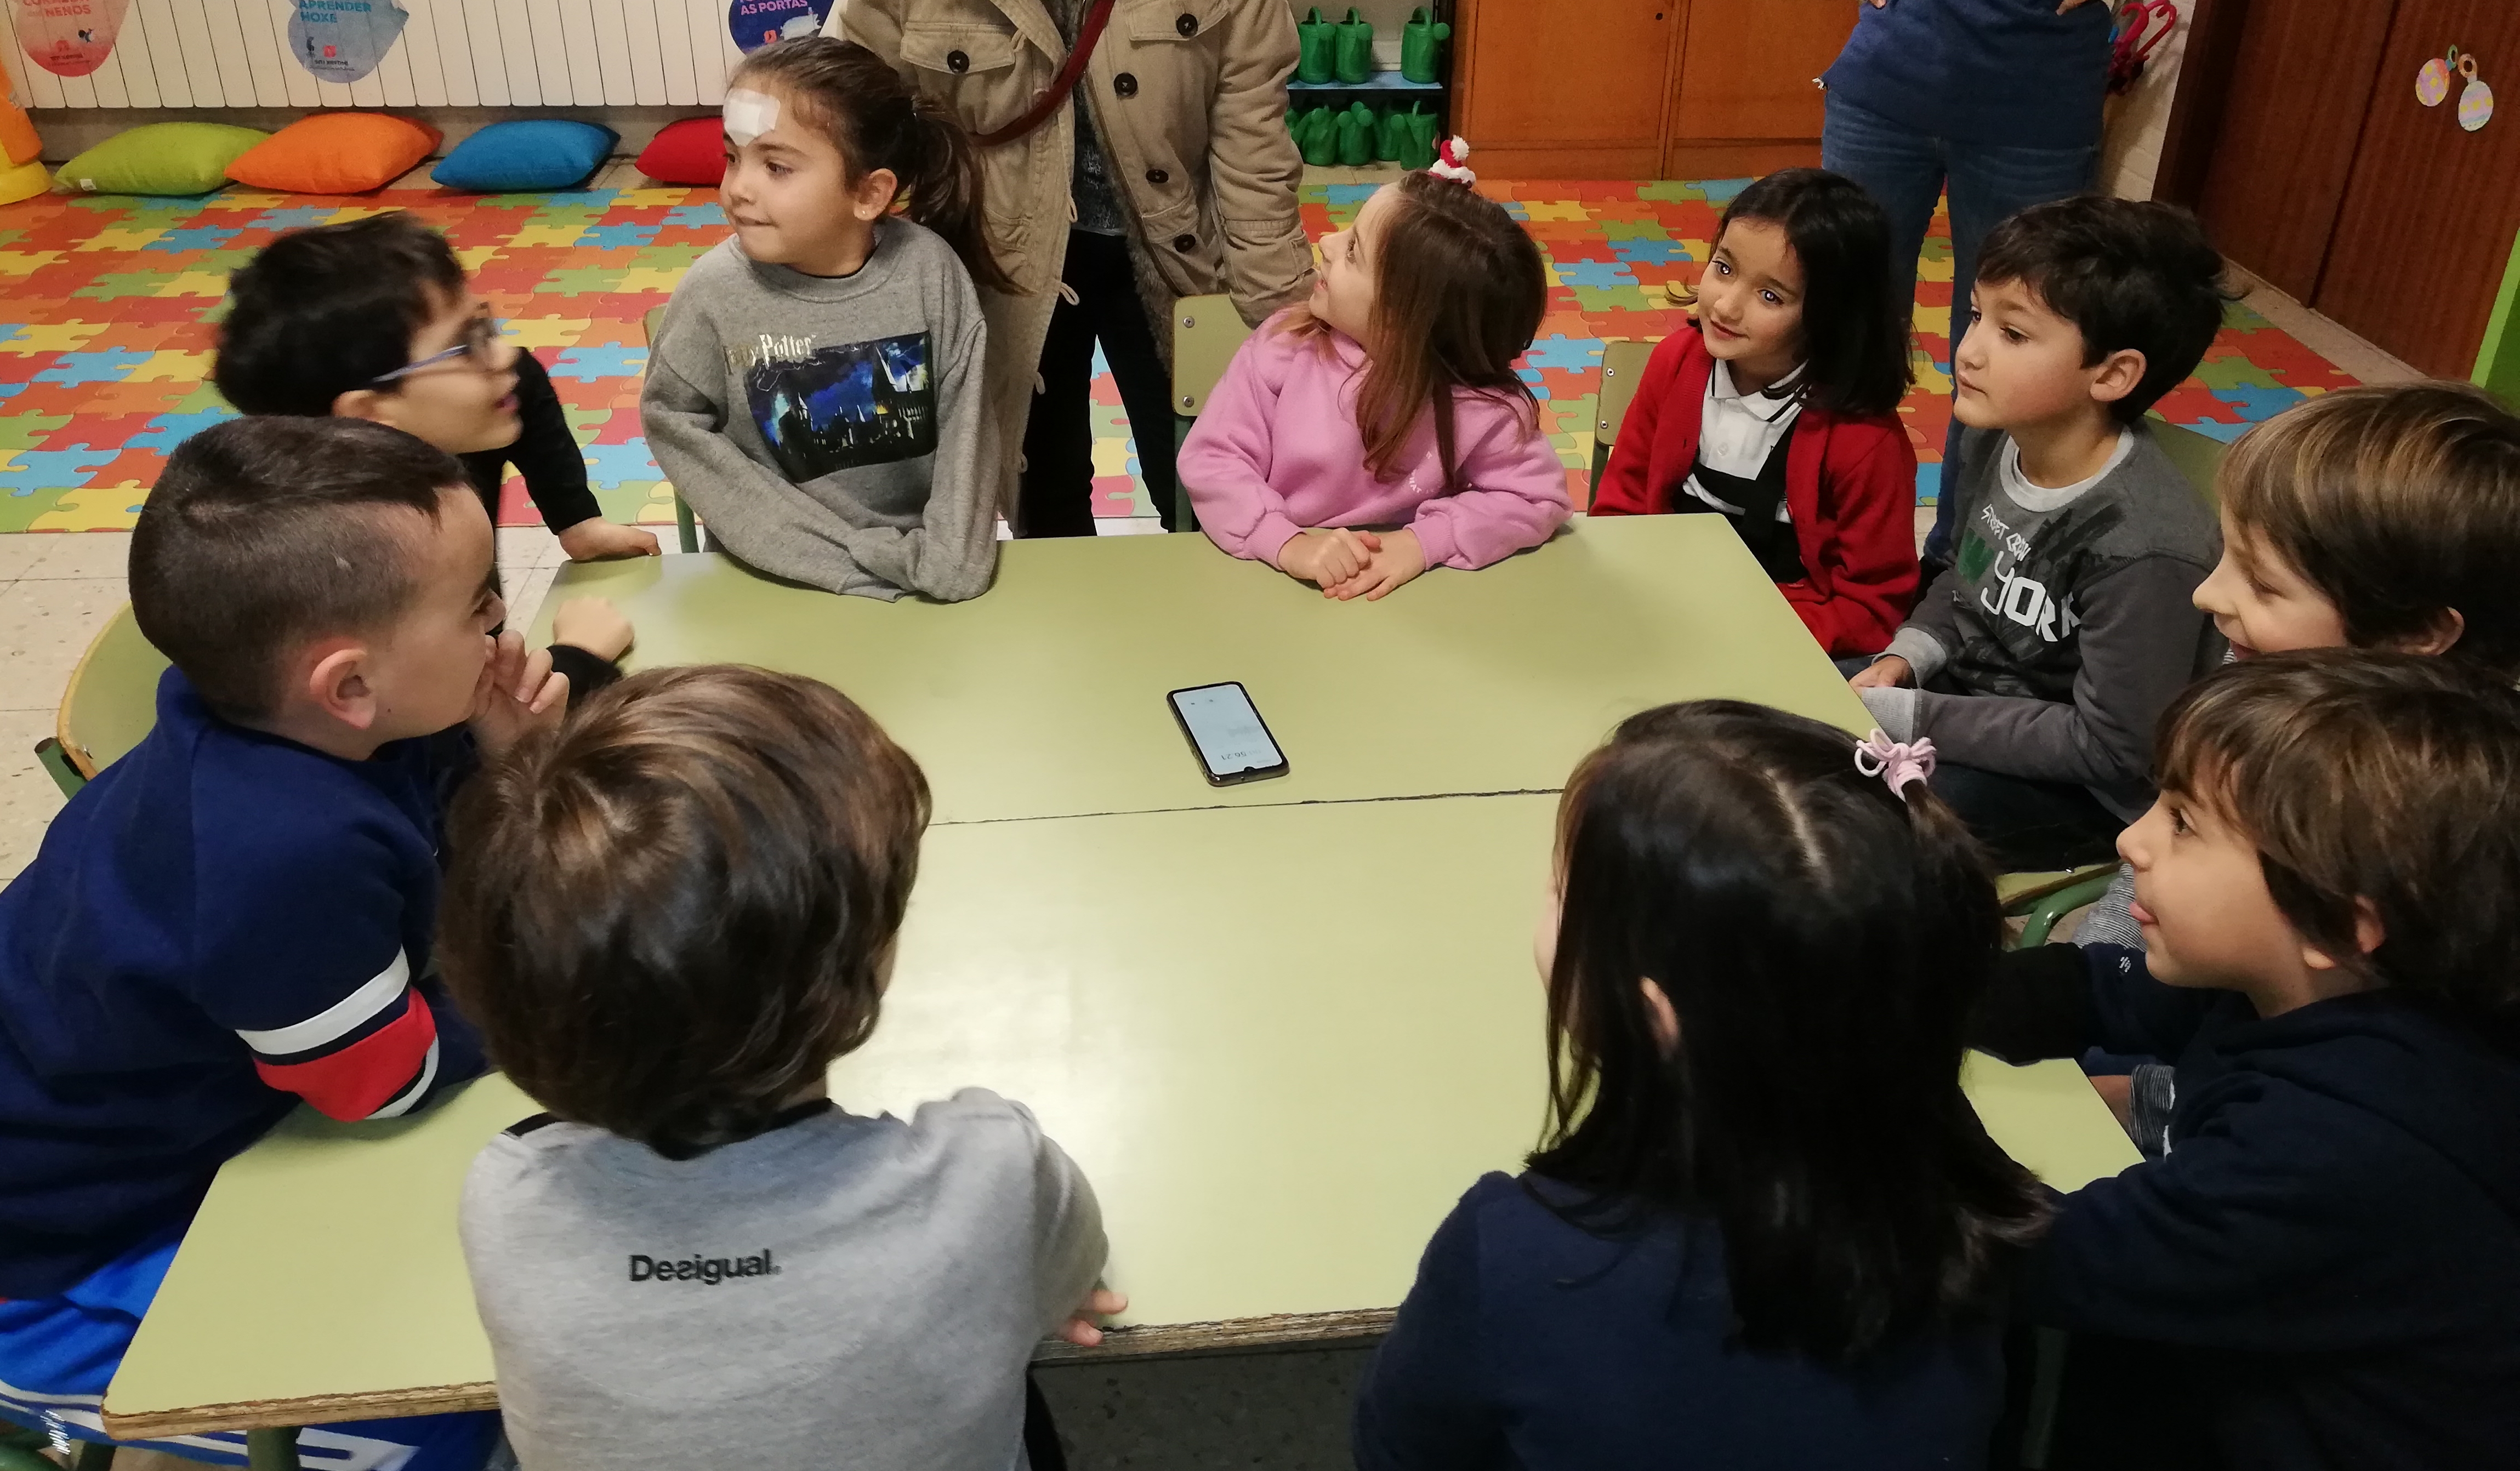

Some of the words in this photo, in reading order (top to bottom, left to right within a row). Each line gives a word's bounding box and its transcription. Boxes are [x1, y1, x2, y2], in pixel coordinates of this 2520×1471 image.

[299, 0, 371, 12] APRENDER
[741, 4, 757, 15] AS
[758, 0, 807, 13] PORTAS
[759, 334, 811, 370] Potter
[1981, 550, 2081, 642] YORK
